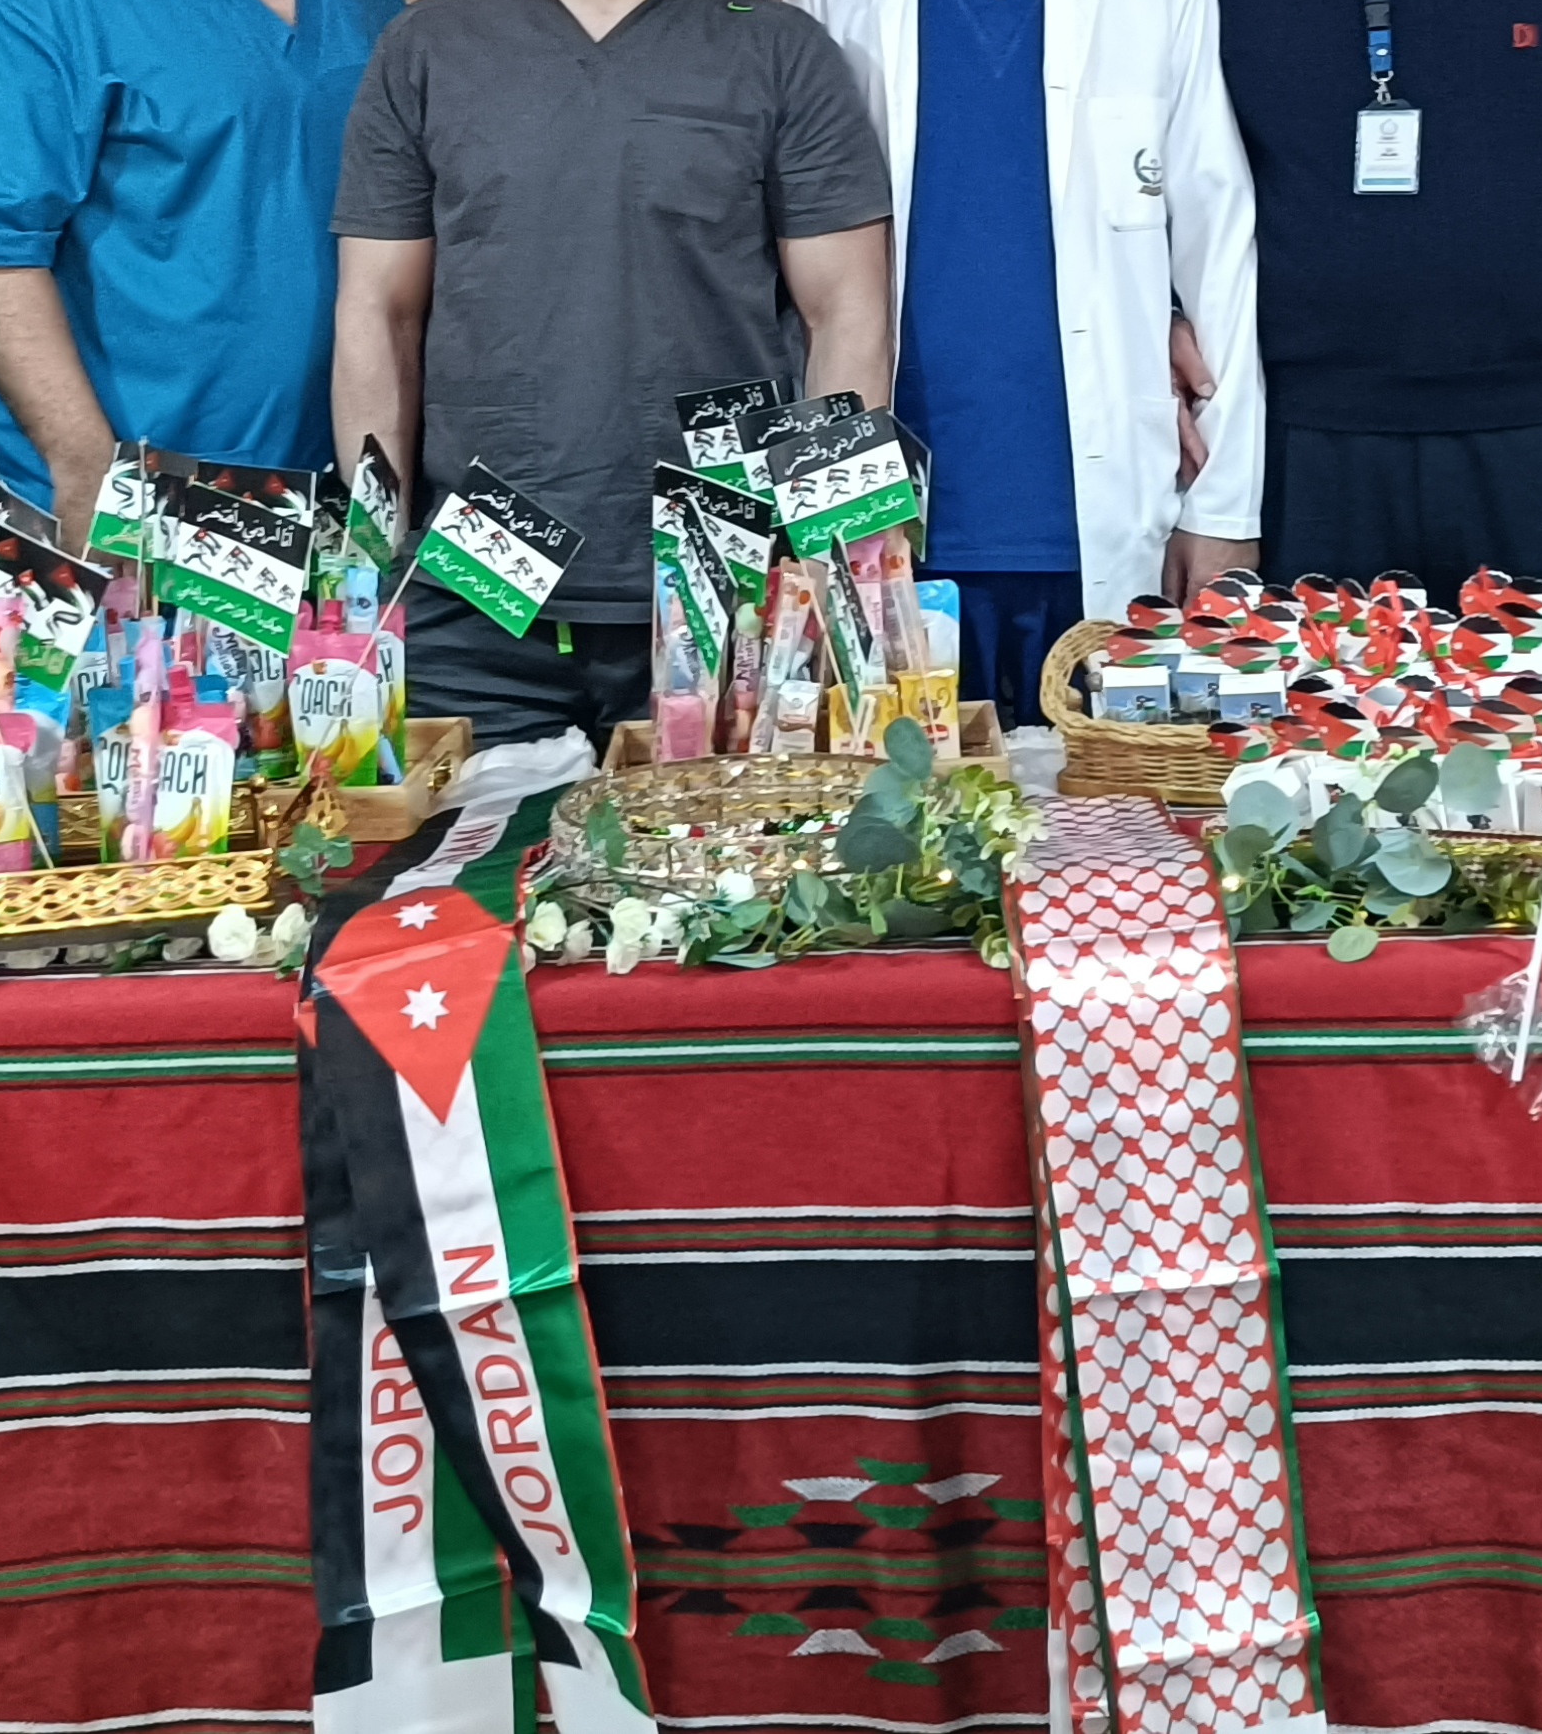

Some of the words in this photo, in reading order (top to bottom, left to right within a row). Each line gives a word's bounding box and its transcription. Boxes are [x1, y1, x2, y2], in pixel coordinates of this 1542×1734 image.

[826, 420, 863, 461] أردني
[860, 415, 876, 437] أنا
[784, 436, 828, 476] وأفتخر
[196, 502, 244, 532] وأفتخر
[468, 489, 516, 519] وأفتخر
[241, 519, 283, 544] أردني
[279, 524, 295, 547] أنا
[509, 513, 555, 538] أردني
[547, 528, 567, 547] أنا
[160, 749, 209, 796] ACH
[442, 1243, 571, 1556] JORDAN
[370, 1324, 427, 1534] JORD
